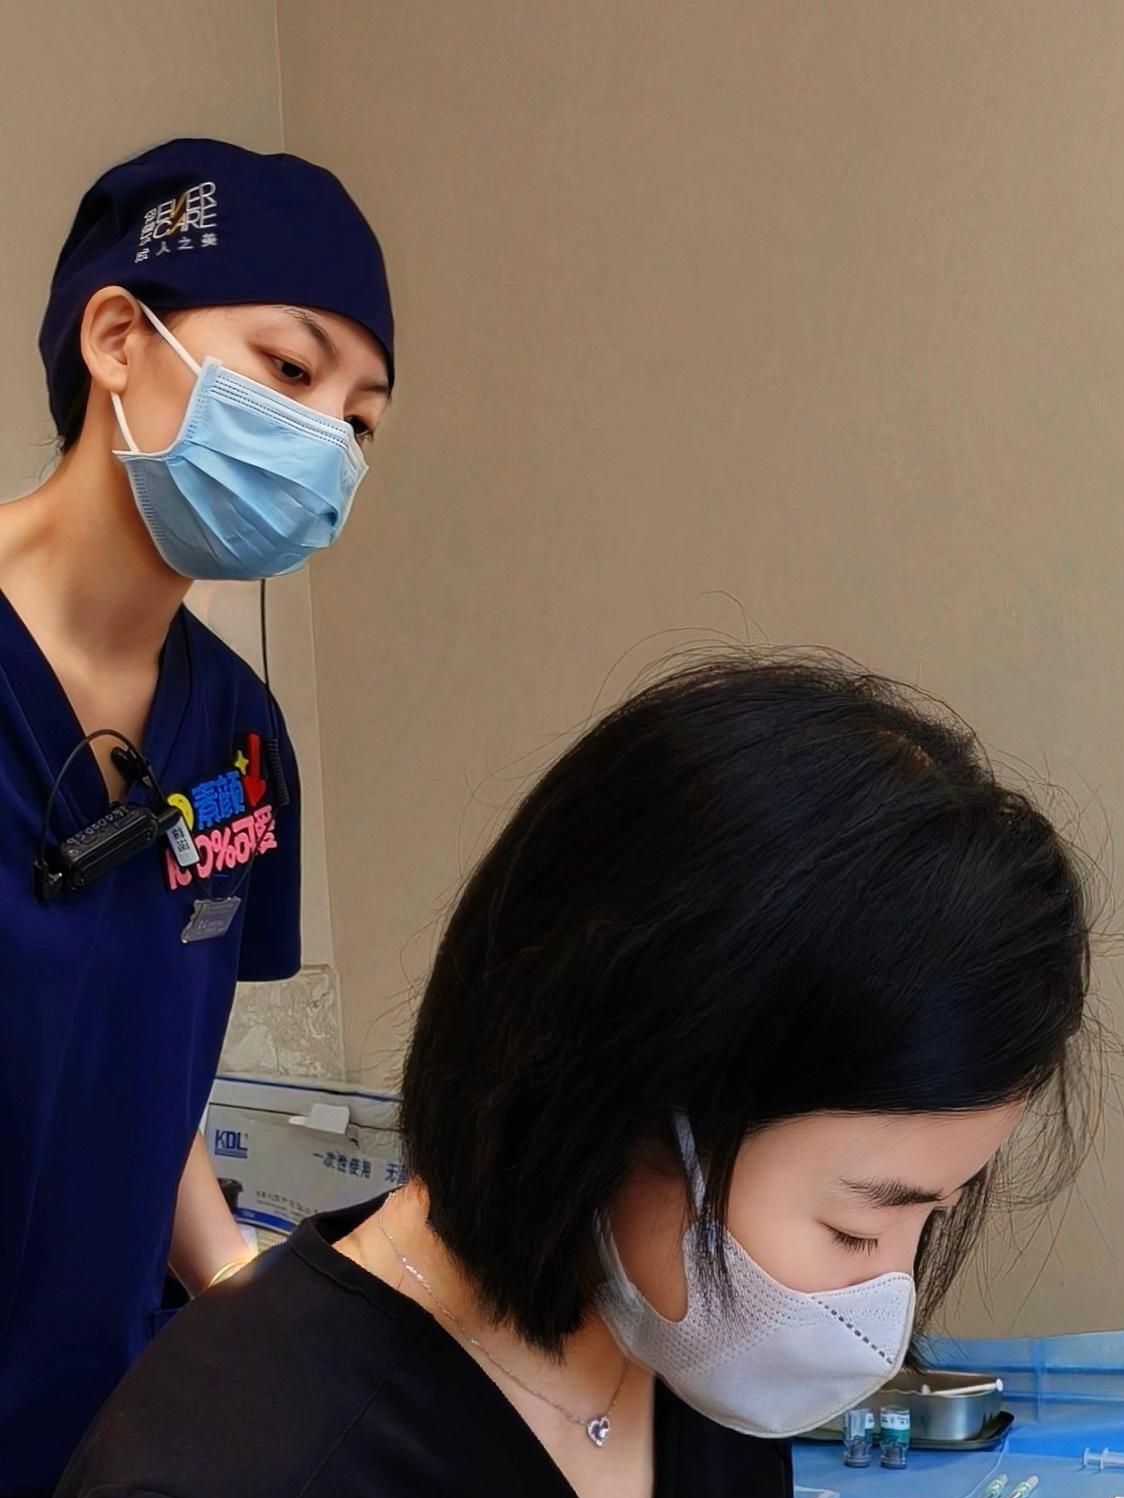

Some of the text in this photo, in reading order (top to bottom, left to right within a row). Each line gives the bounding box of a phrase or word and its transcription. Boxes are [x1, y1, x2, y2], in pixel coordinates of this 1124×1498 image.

[215, 1129, 248, 1151] KDL
[312, 1151, 371, 1179] 一次性使用
